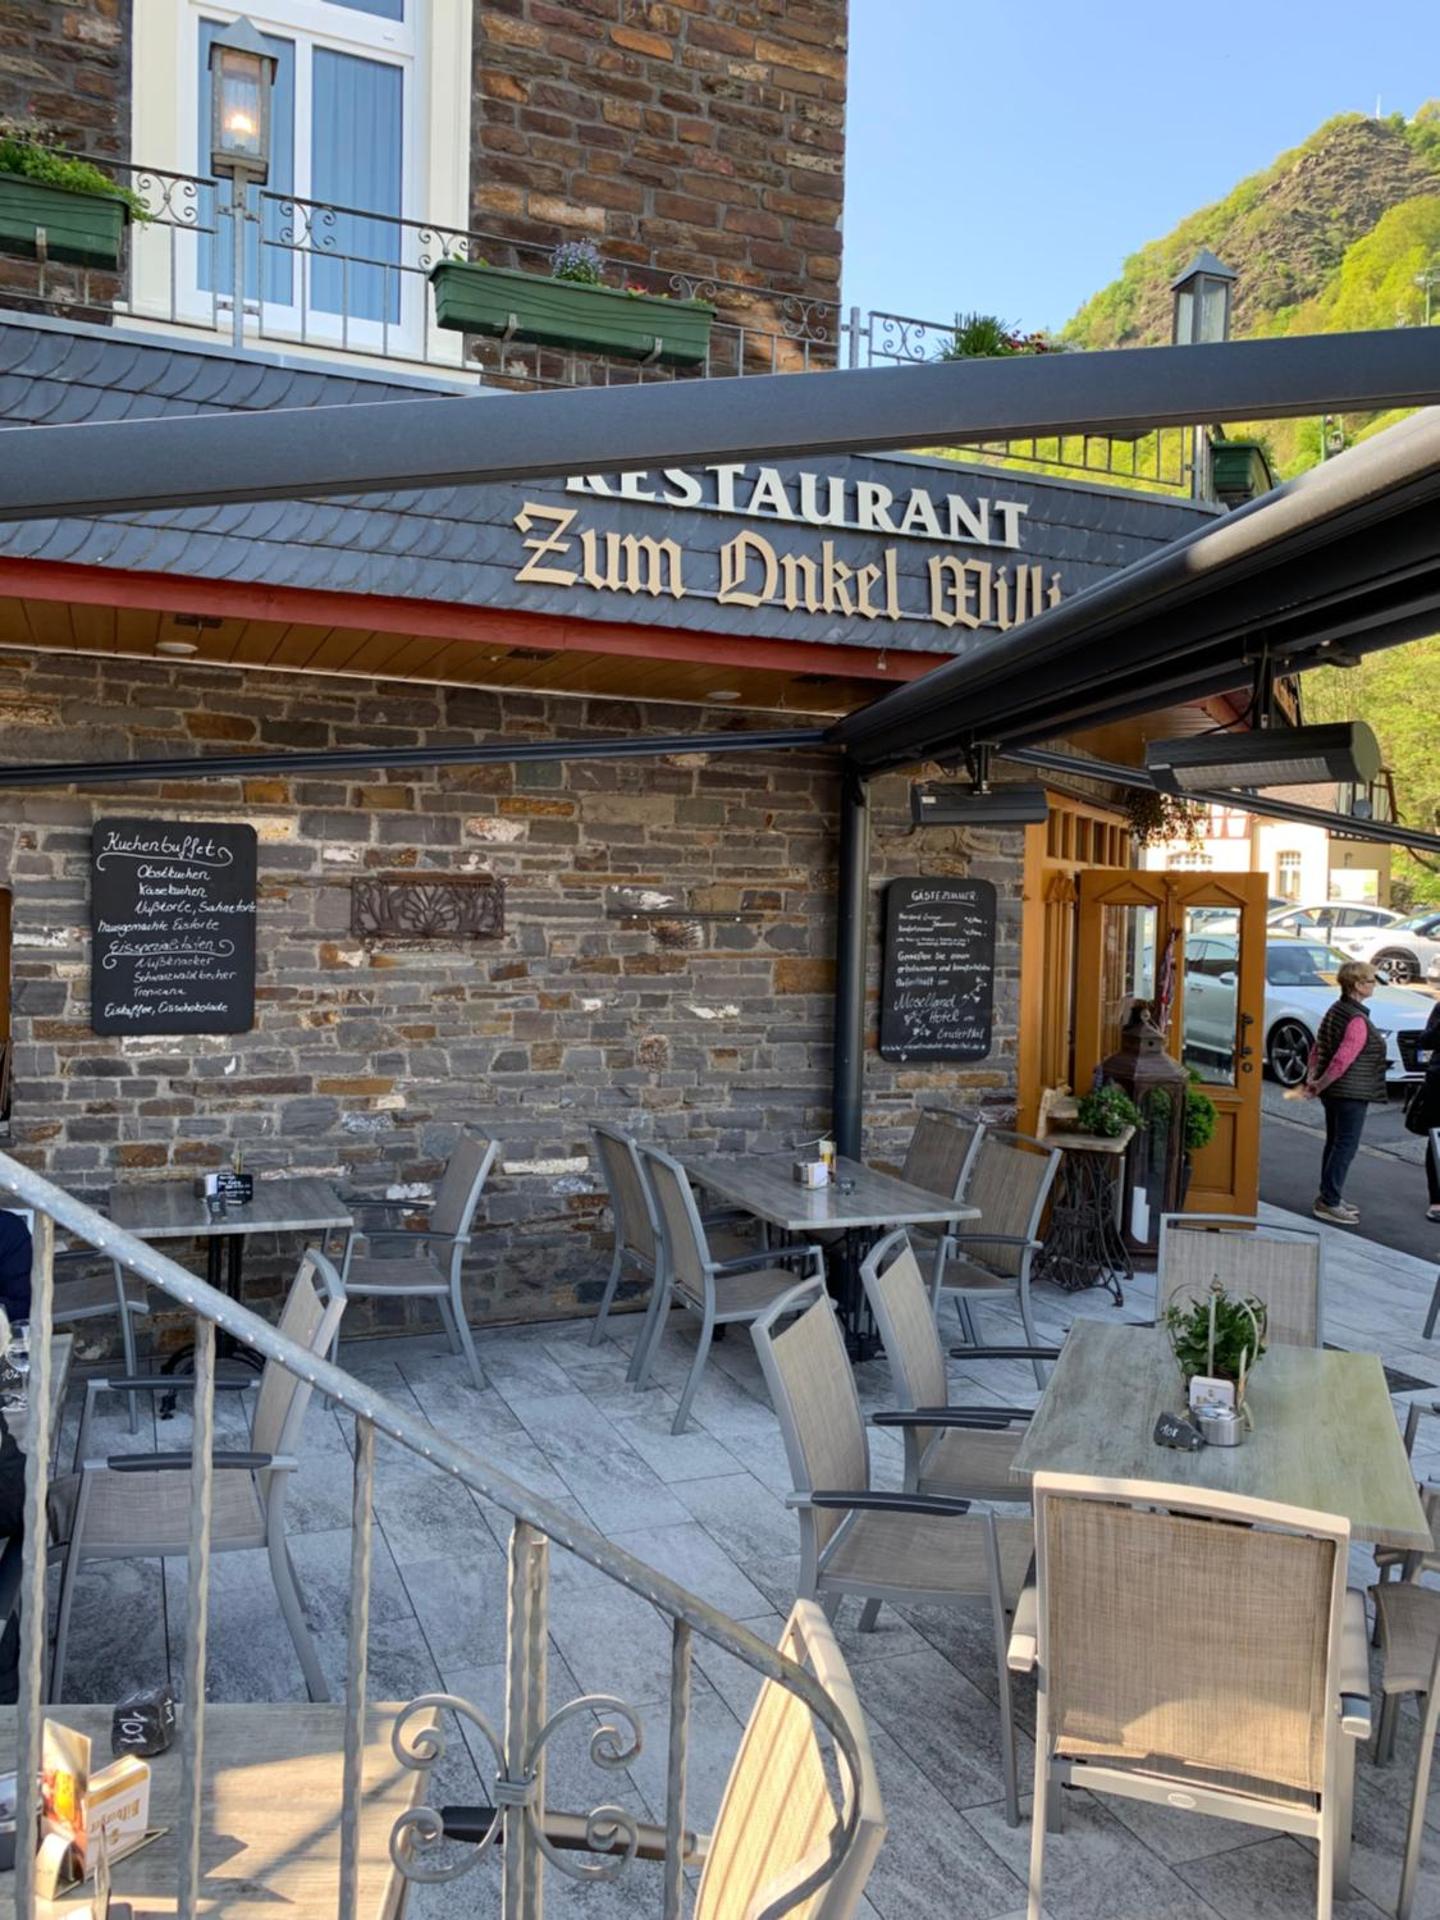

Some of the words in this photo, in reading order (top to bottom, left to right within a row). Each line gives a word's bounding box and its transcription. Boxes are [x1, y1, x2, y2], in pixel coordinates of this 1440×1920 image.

[513, 502, 686, 600] Zum
[716, 529, 901, 620] Onkel
[928, 555, 1062, 631] Willi
[103, 831, 215, 859] Kuchenbuffet
[137, 864, 211, 880] Obstkuchen
[172, 917, 220, 932] Eistorte
[133, 986, 187, 997] Tropicana
